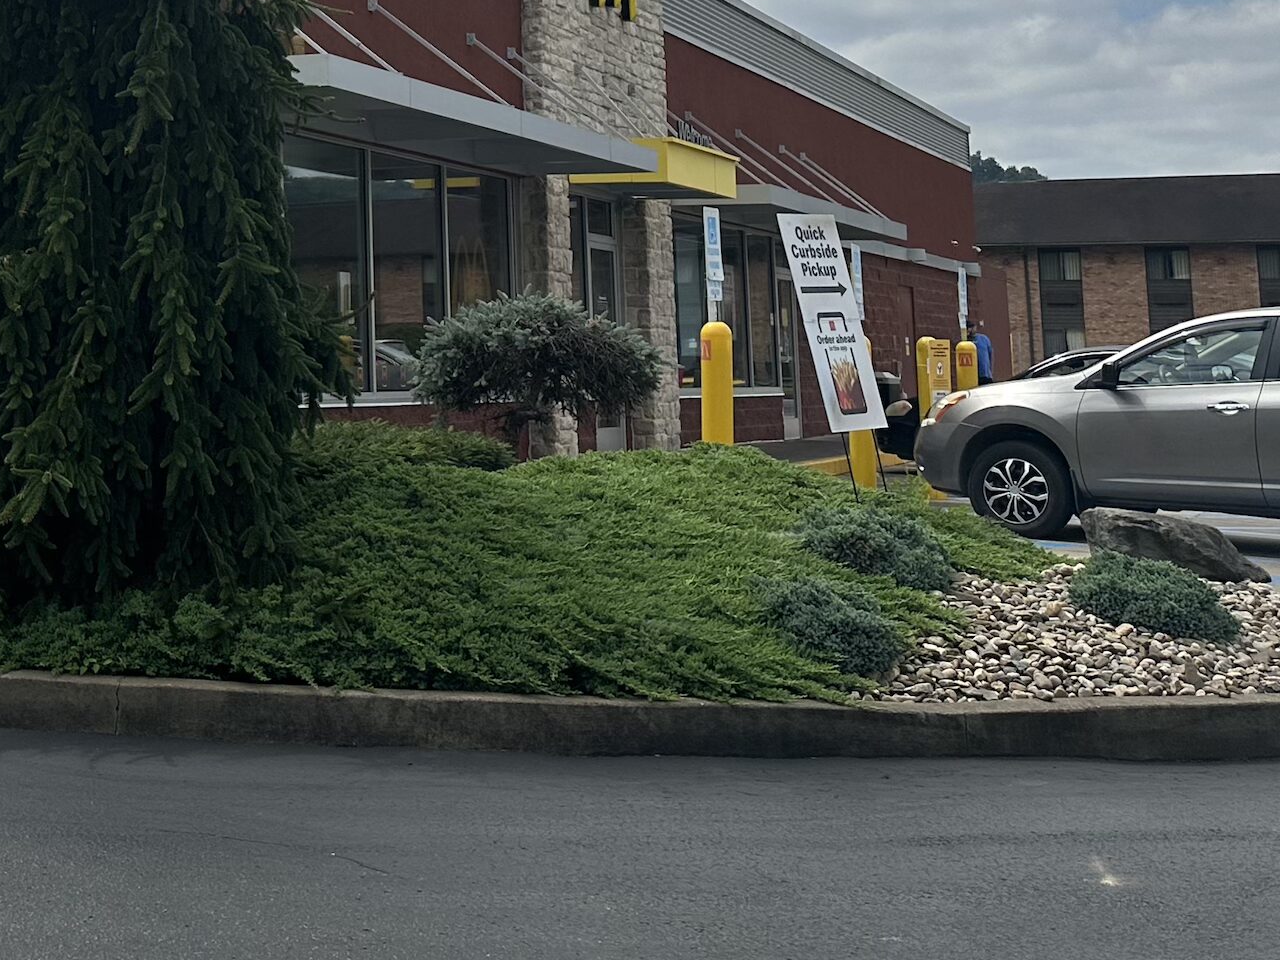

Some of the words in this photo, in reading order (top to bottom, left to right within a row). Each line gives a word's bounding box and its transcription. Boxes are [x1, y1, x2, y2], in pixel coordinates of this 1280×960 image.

[795, 225, 826, 243] Quick
[791, 243, 838, 259] Curbside
[801, 261, 837, 280] Pickup
[816, 335, 835, 344] Order
[836, 334, 856, 343] ahead
